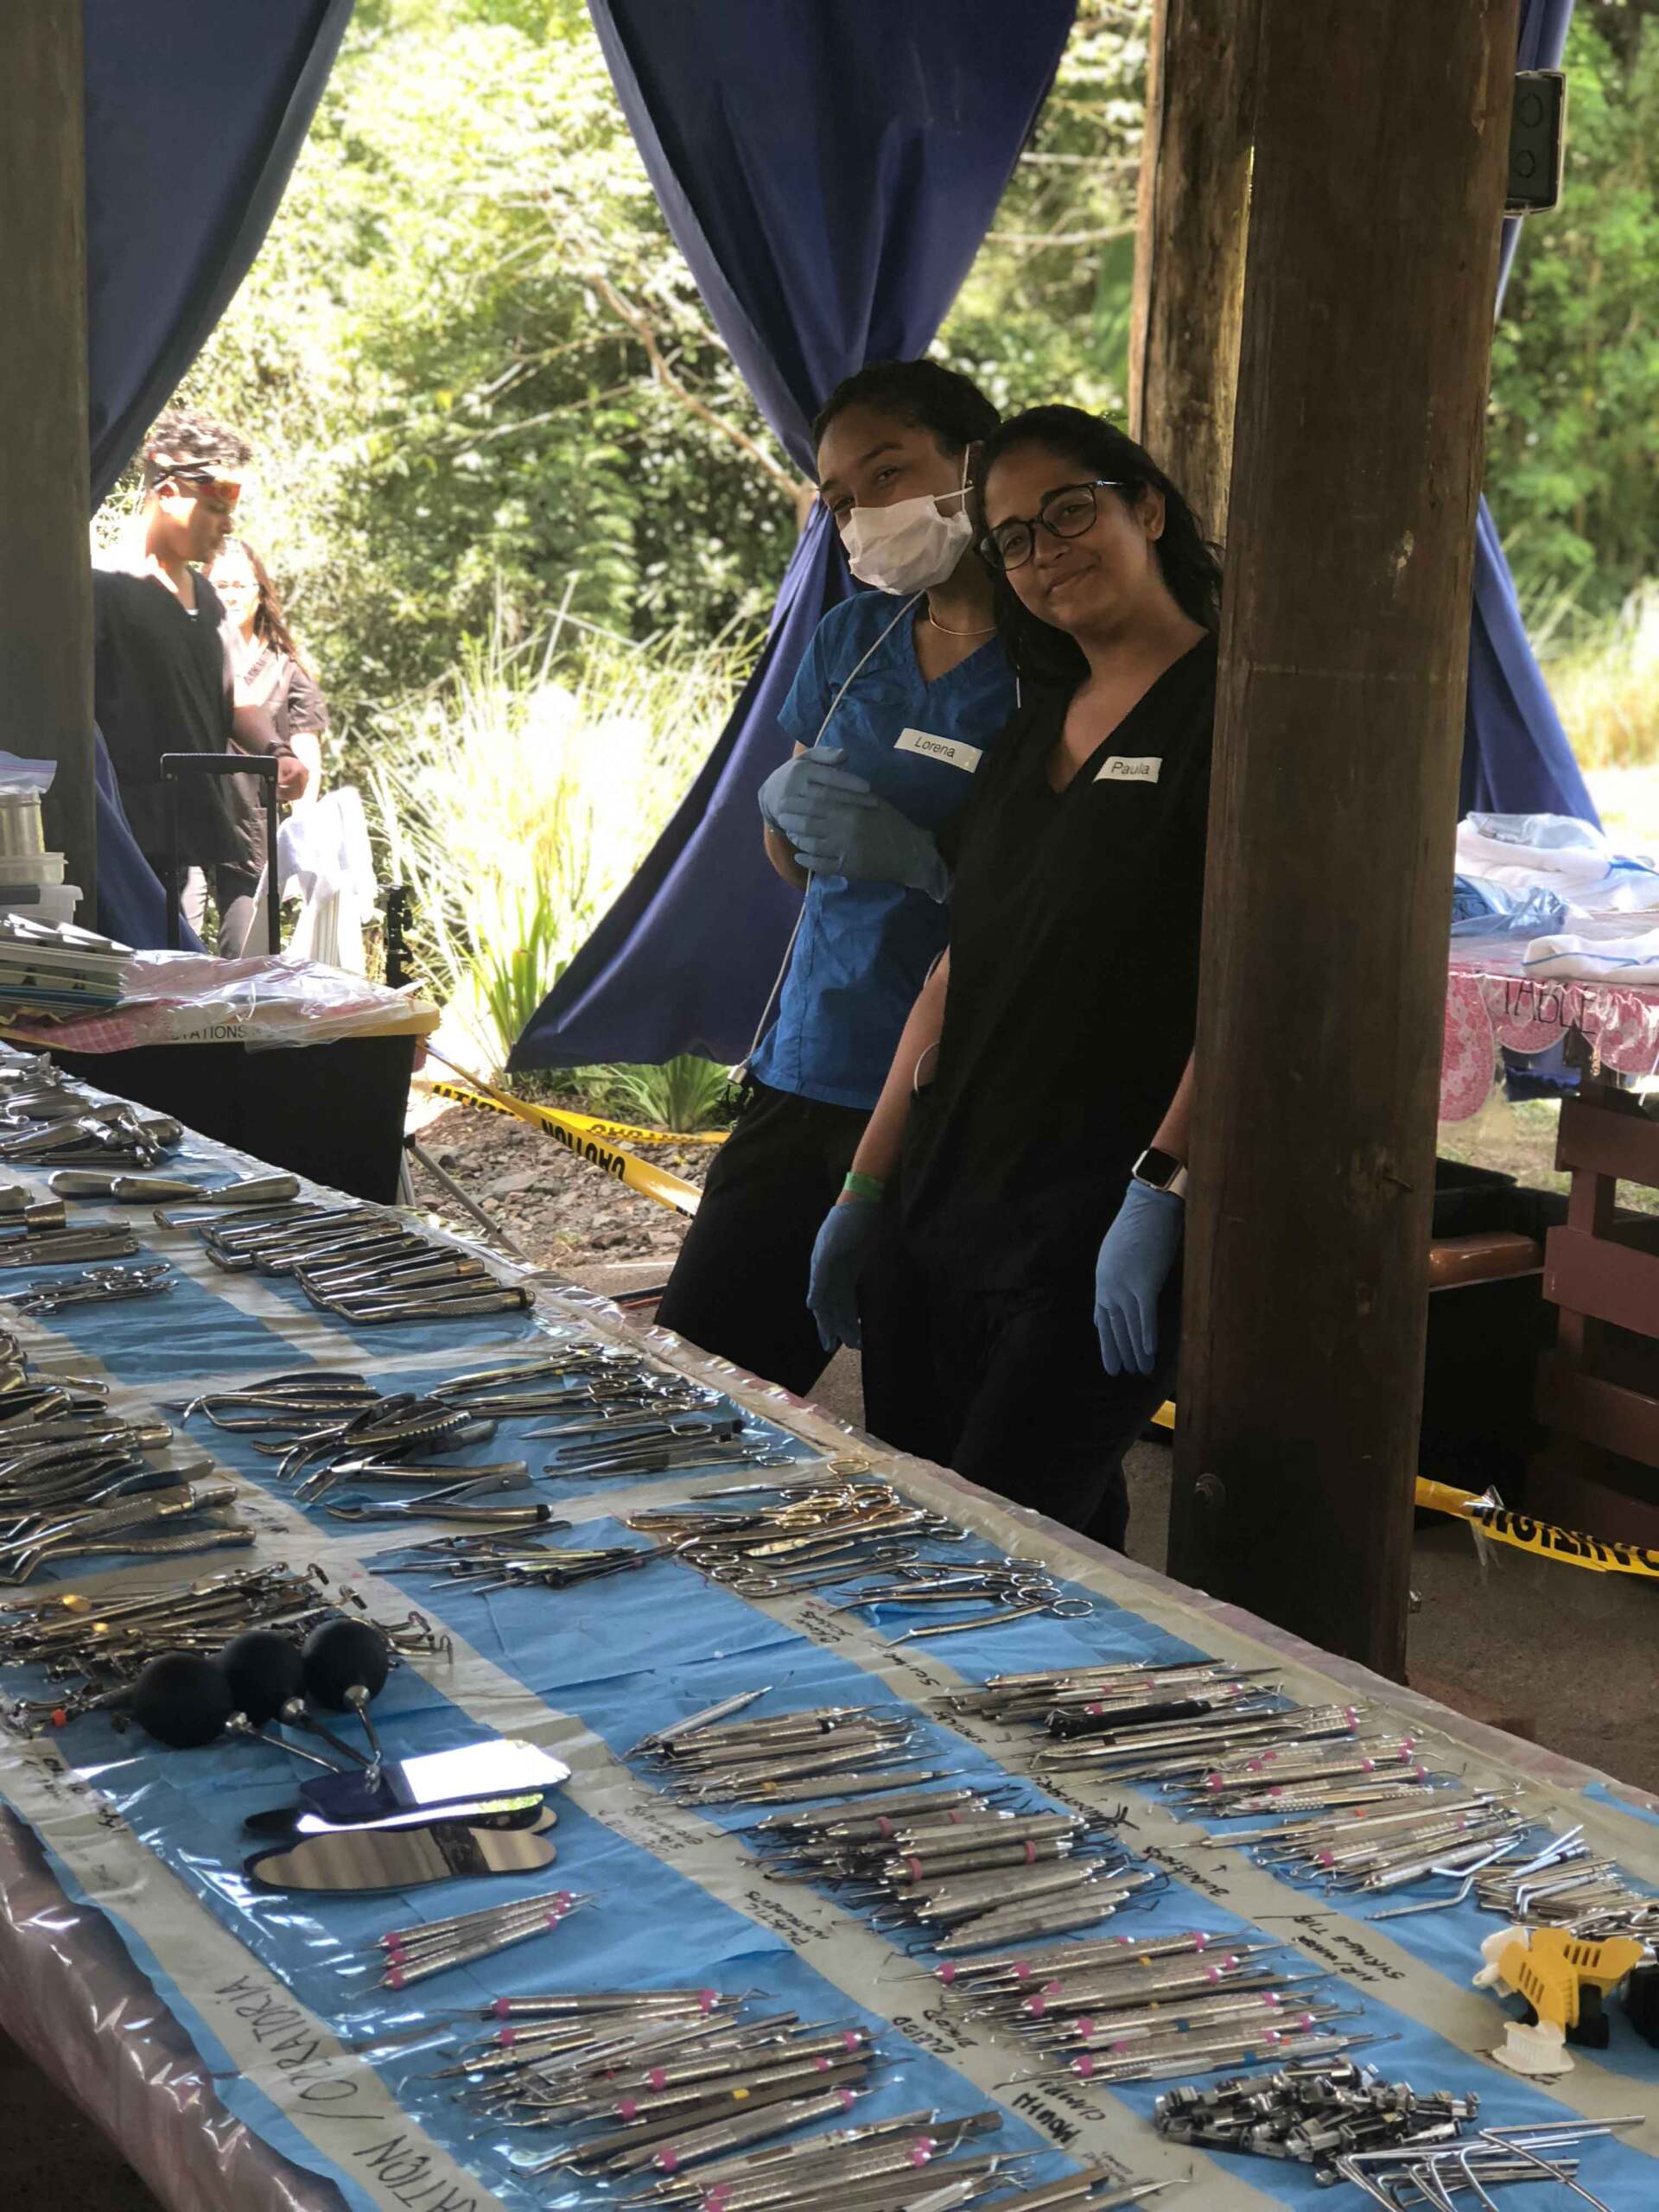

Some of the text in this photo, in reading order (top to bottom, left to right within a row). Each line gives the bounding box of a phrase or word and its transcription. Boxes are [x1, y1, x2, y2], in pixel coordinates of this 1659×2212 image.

[913, 735, 957, 760] Lorena
[1111, 760, 1151, 777] Paula
[171, 1025, 247, 1039] ATIONS
[352, 2134, 475, 2212] ATION
